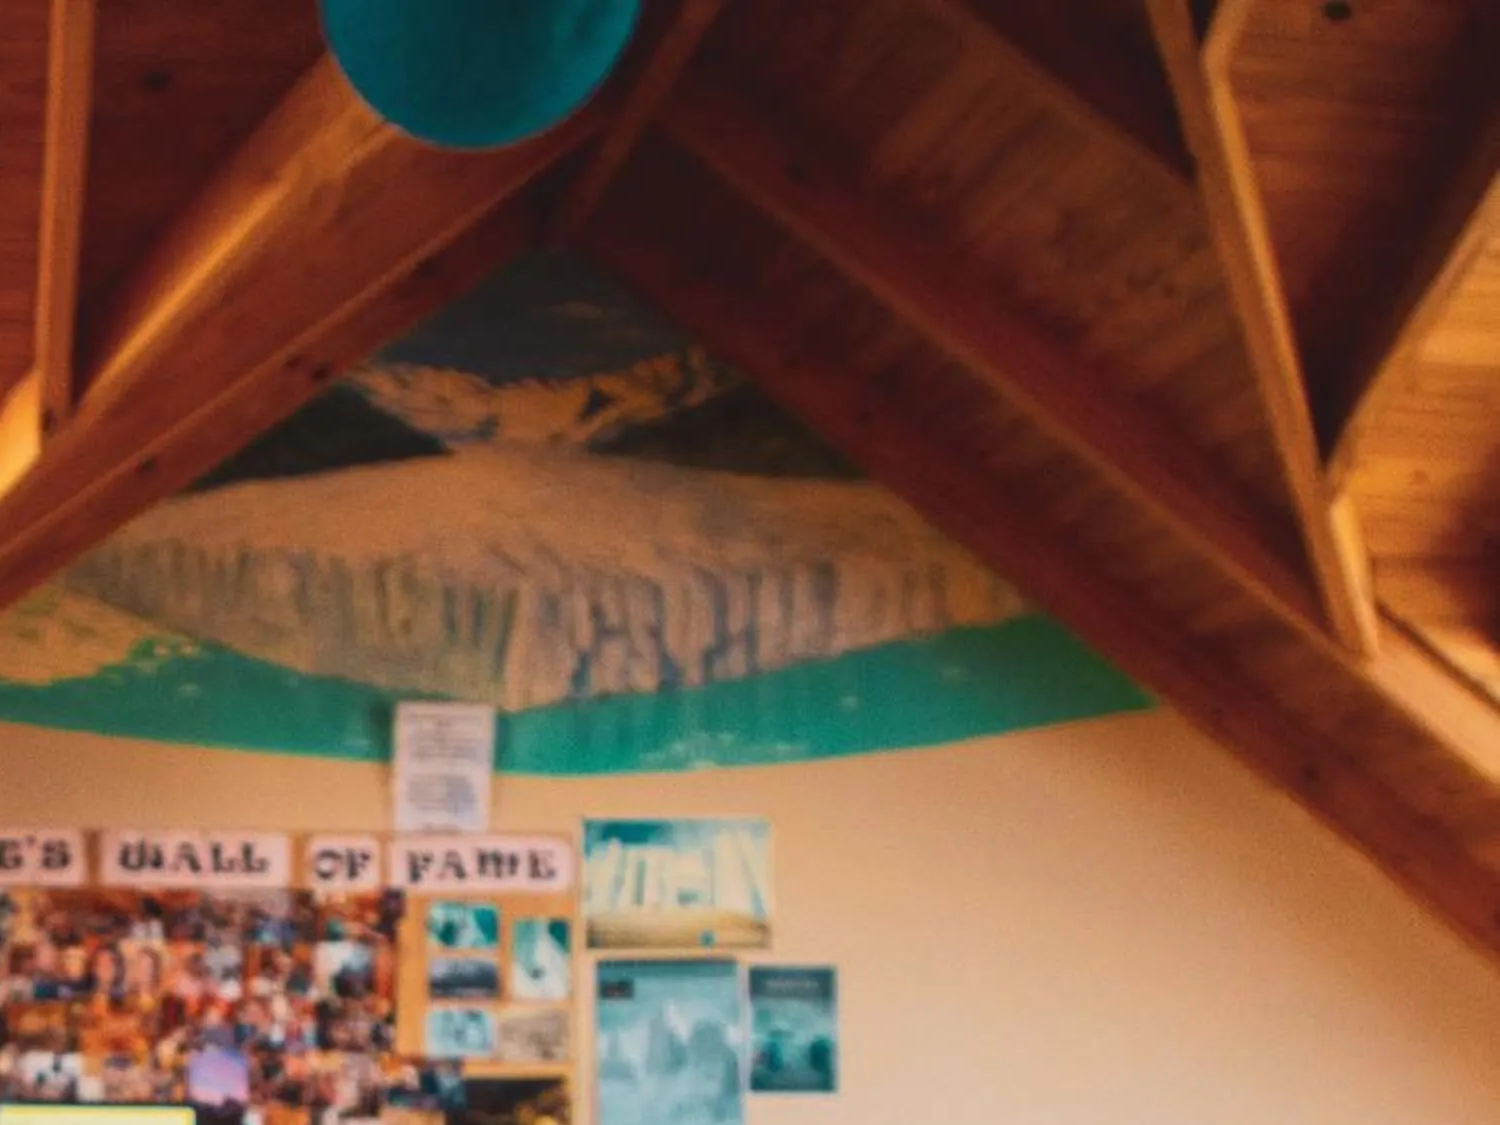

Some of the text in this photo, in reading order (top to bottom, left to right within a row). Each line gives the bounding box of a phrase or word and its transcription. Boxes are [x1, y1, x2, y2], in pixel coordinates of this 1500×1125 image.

[117, 839, 270, 874] WALL
[315, 848, 372, 880] OF
[407, 848, 557, 883] FAME
